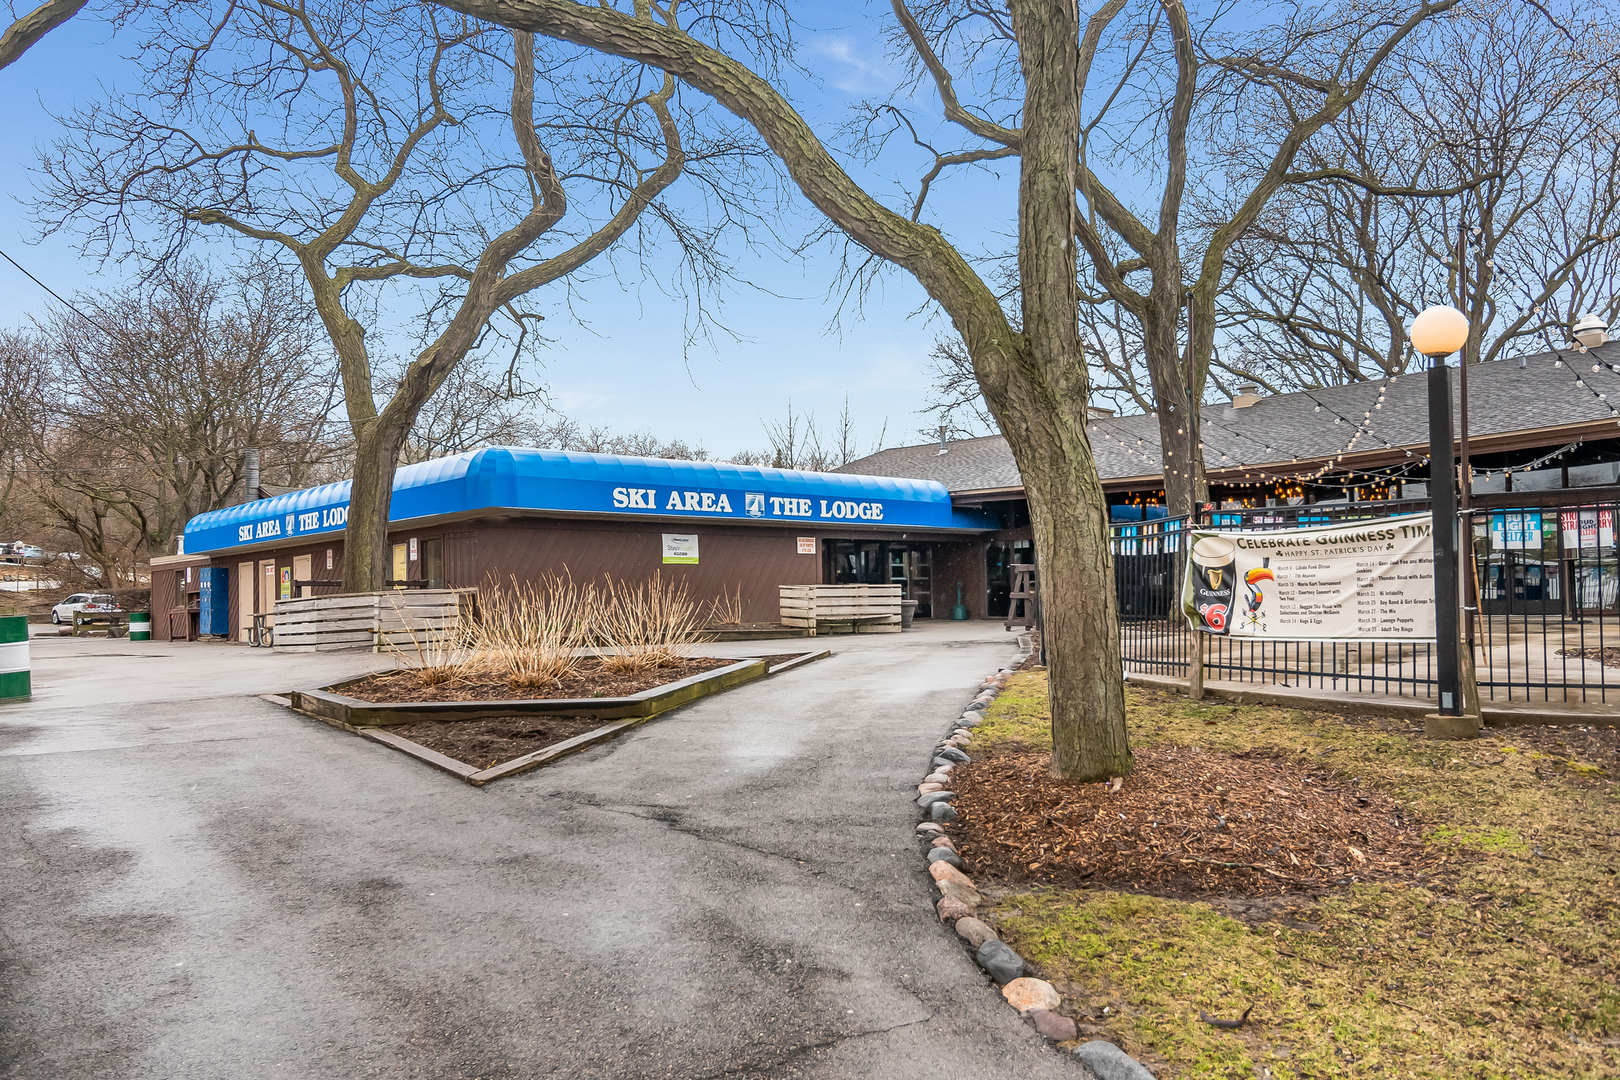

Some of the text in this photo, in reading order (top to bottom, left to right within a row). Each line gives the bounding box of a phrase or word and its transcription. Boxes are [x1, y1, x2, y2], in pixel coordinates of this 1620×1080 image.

[613, 488, 732, 512] SKI AREA
[770, 496, 884, 520] THE LODGE
[238, 519, 281, 542] SKI AREA
[298, 512, 320, 531] THE
[1498, 521, 1536, 530] LIGHT
[1236, 525, 1430, 549] CELEBRATE GUINNESS TIM
[1501, 532, 1534, 542] SELTZER
[1324, 546, 1364, 555] PATRICK'S
[1200, 588, 1230, 597] GUINNESS
